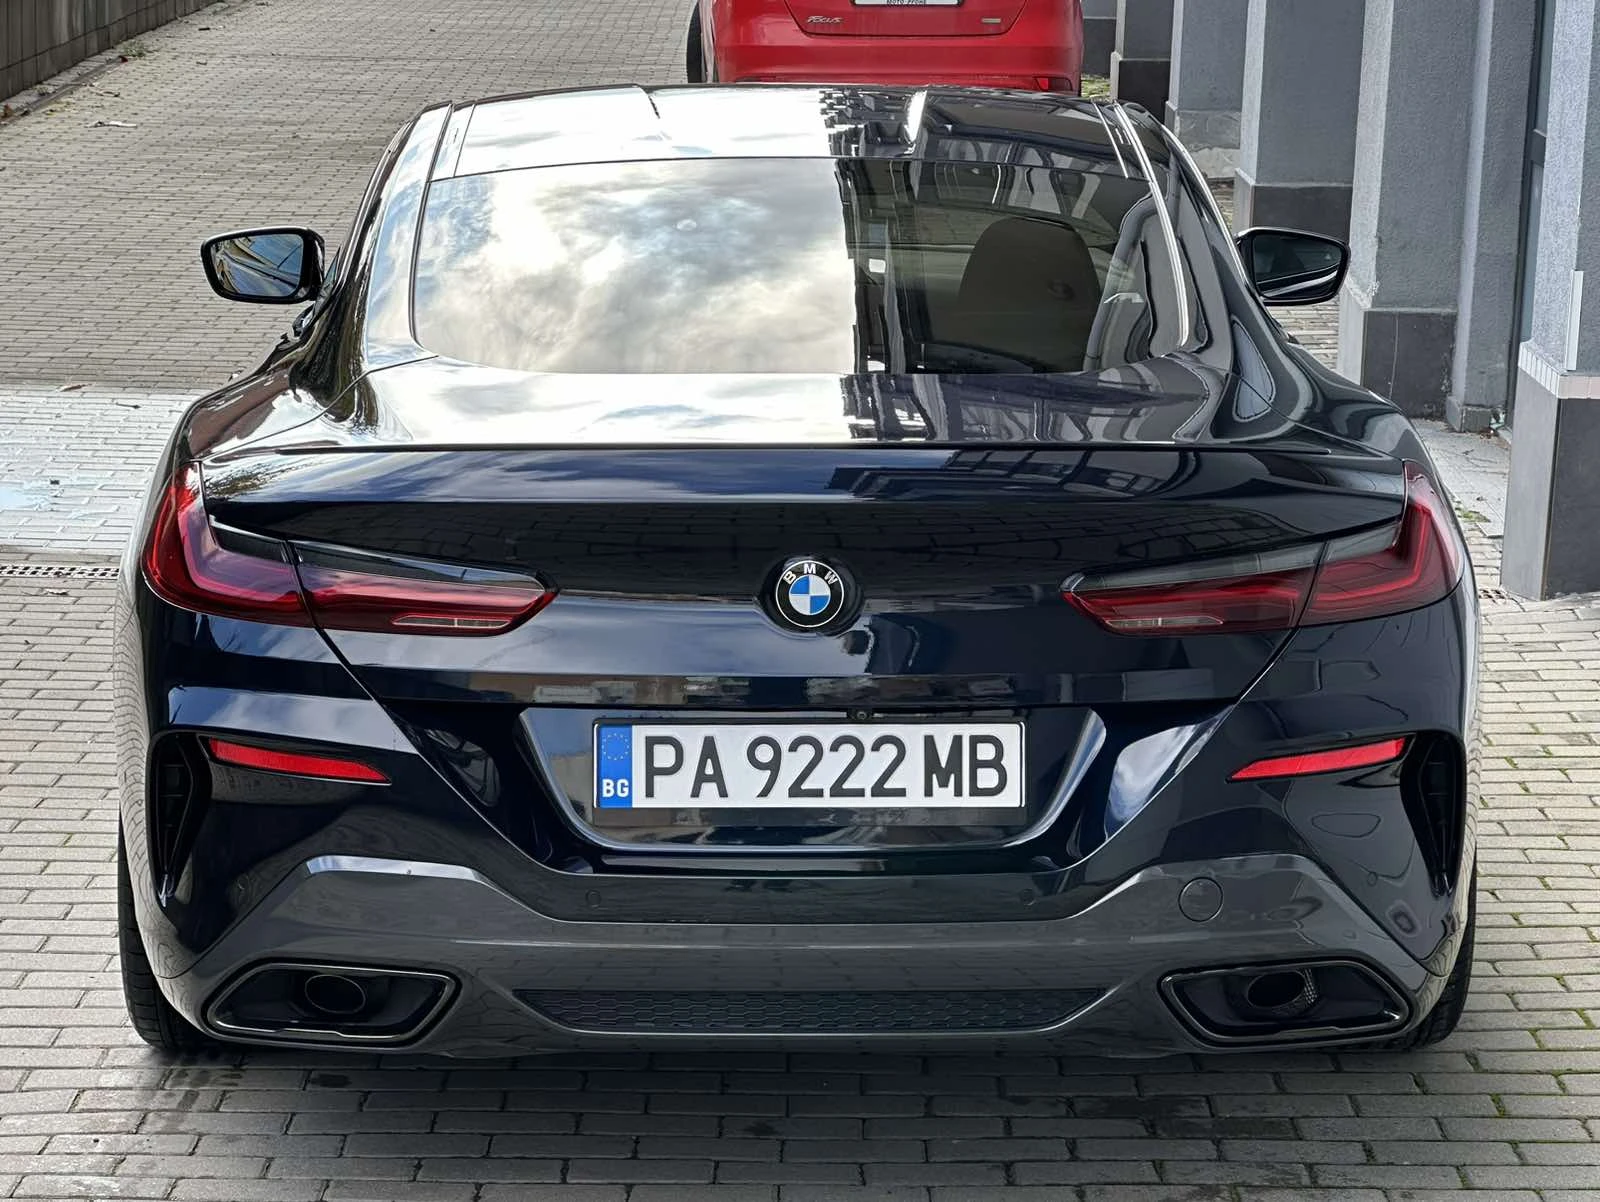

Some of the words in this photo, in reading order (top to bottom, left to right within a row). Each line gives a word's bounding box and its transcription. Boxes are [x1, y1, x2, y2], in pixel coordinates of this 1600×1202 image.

[783, 563, 838, 585] BMW
[645, 735, 728, 798] PA
[747, 735, 907, 798] 9222
[924, 734, 1008, 798] MB
[602, 778, 629, 798] BG
